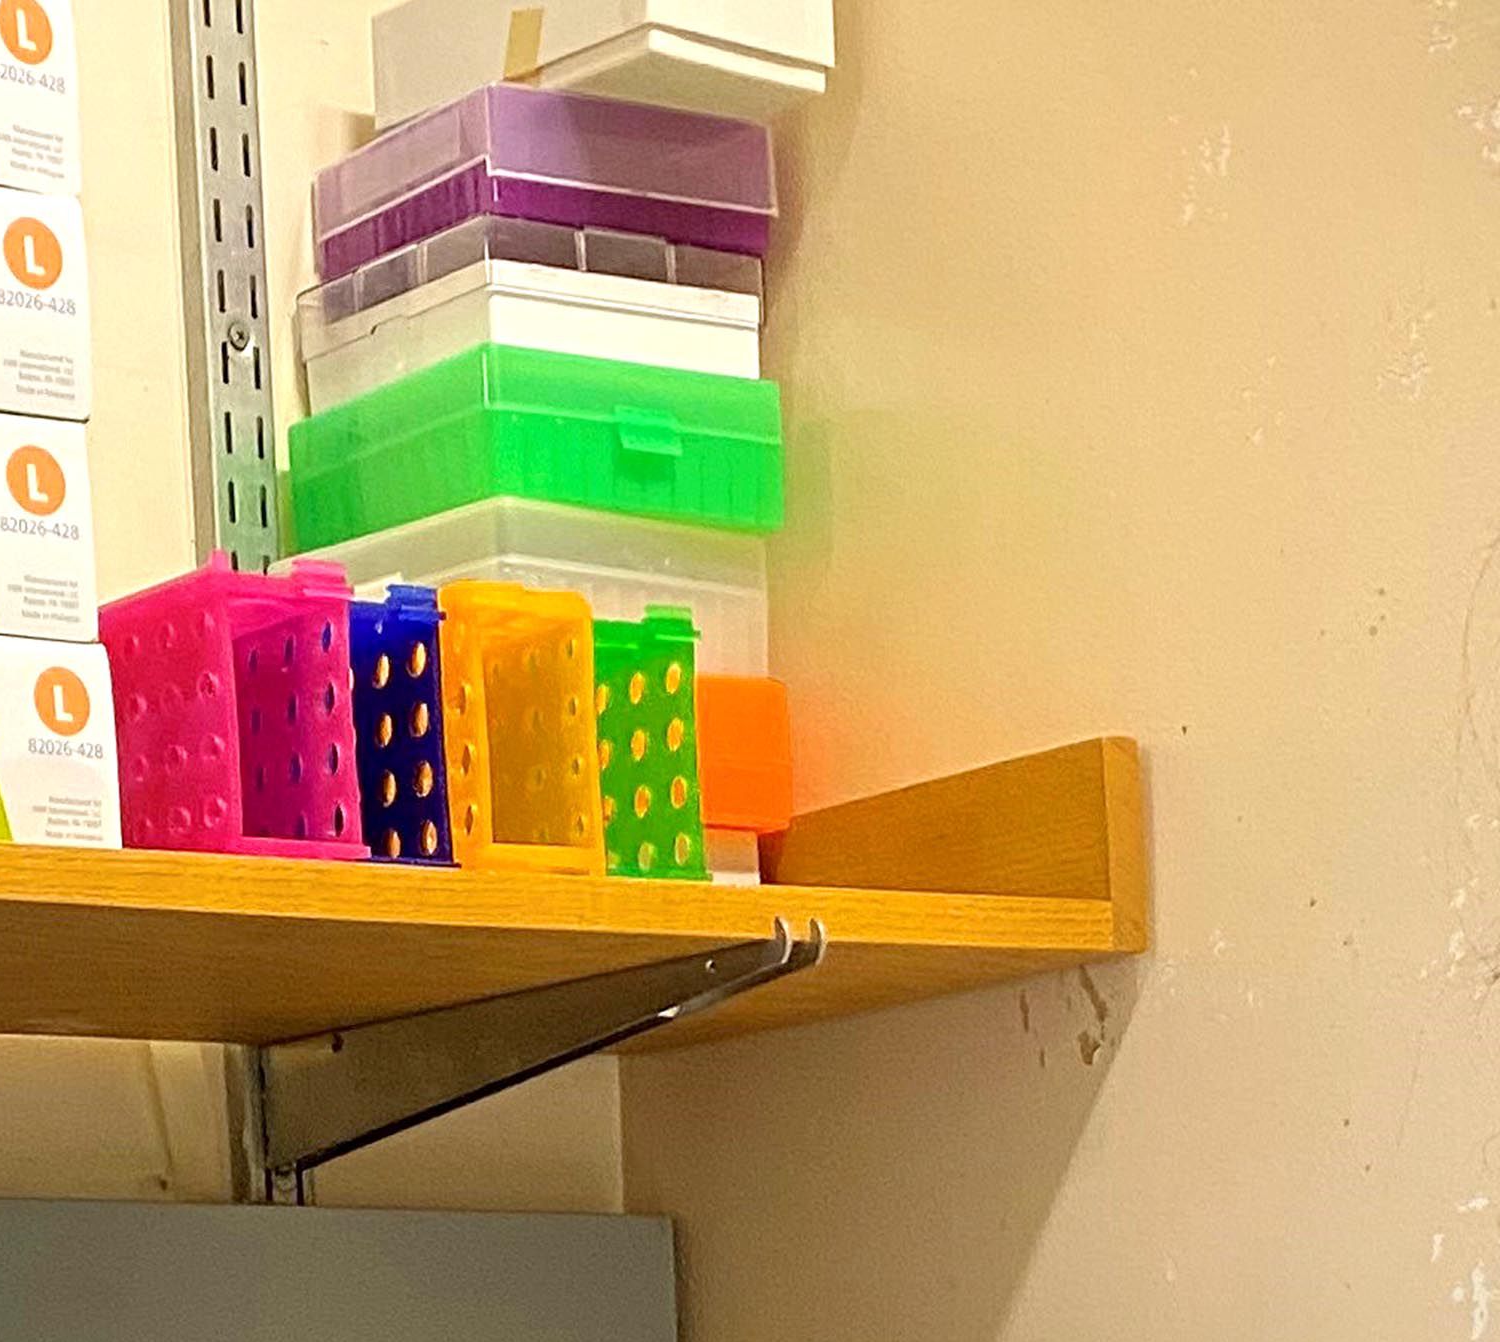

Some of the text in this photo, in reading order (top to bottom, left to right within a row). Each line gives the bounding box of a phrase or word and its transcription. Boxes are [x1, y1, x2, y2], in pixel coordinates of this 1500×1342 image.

[15, 8, 37, 51] L
[23, 234, 45, 276] L
[27, 463, 48, 503] L
[0, 517, 80, 541] 82026-428
[53, 684, 74, 722] L
[28, 738, 103, 759] 82026-428
